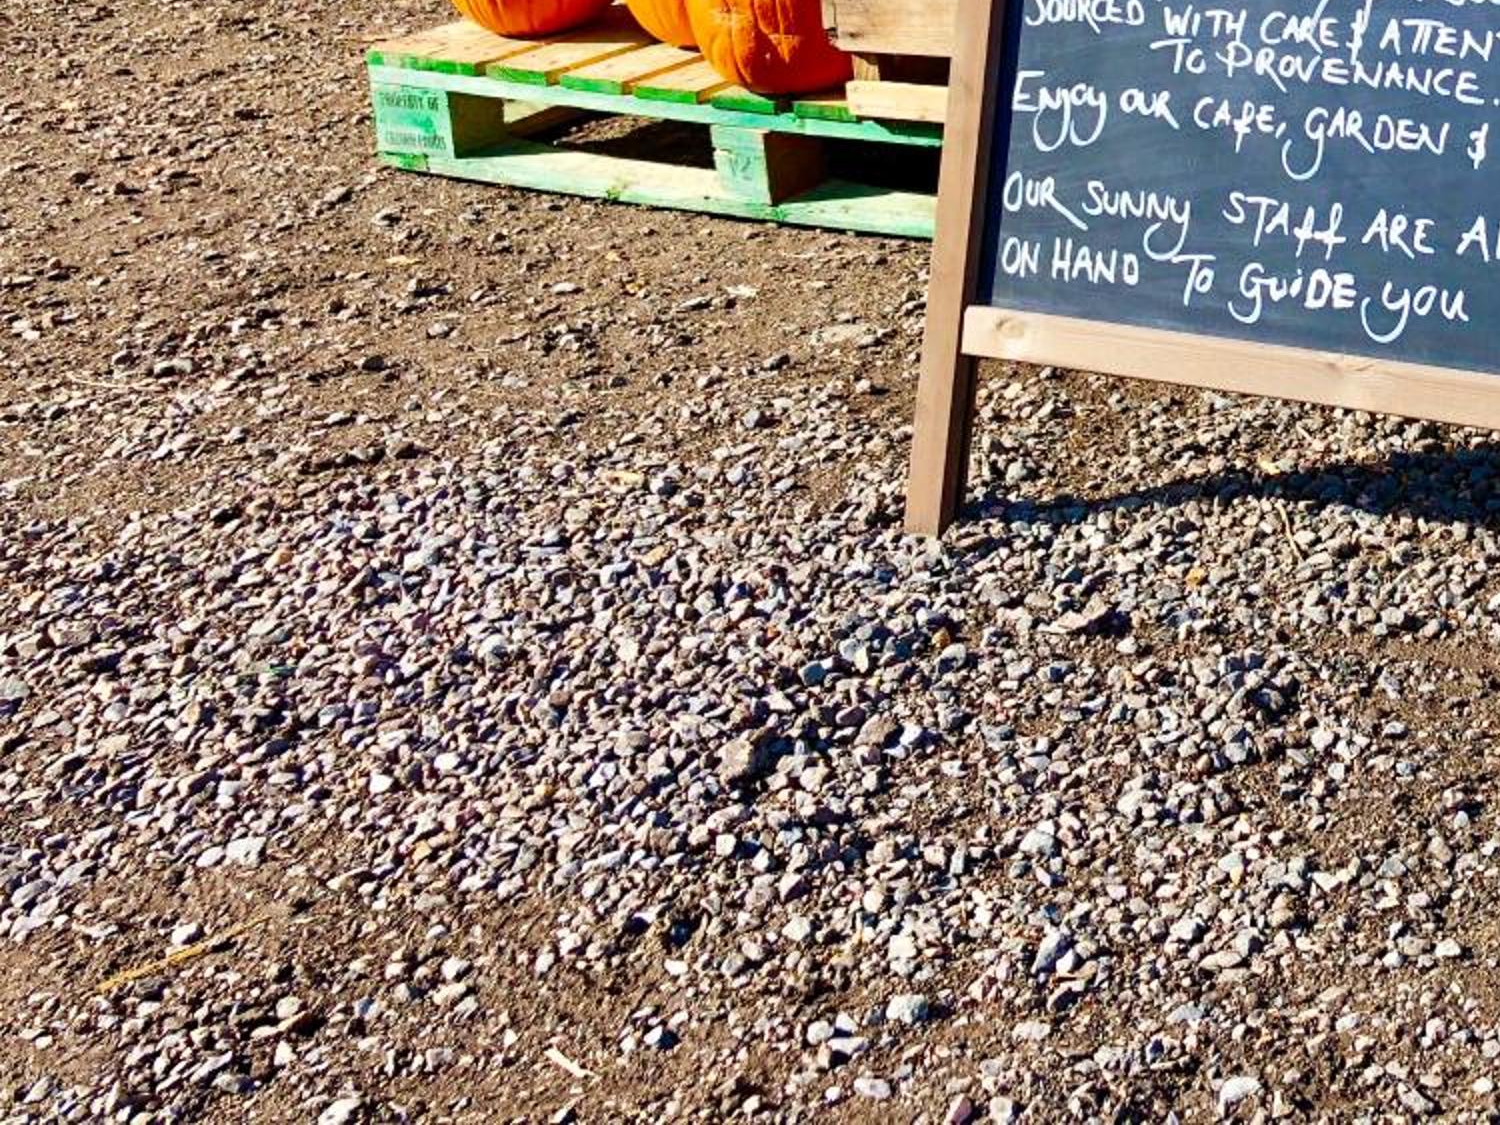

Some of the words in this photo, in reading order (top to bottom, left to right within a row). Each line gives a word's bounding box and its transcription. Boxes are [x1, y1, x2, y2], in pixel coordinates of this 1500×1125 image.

[1150, 38, 1207, 75] TO
[1163, 5, 1242, 42] WITH
[1258, 11, 1339, 58] CARE
[1120, 87, 1180, 130] OUR
[1282, 107, 1449, 180] GARDEN
[1003, 171, 1088, 231] OUR
[1363, 214, 1436, 259] ARE
[1003, 237, 1038, 276] ON
[1051, 242, 1139, 286] HAND
[1171, 254, 1216, 306] TO
